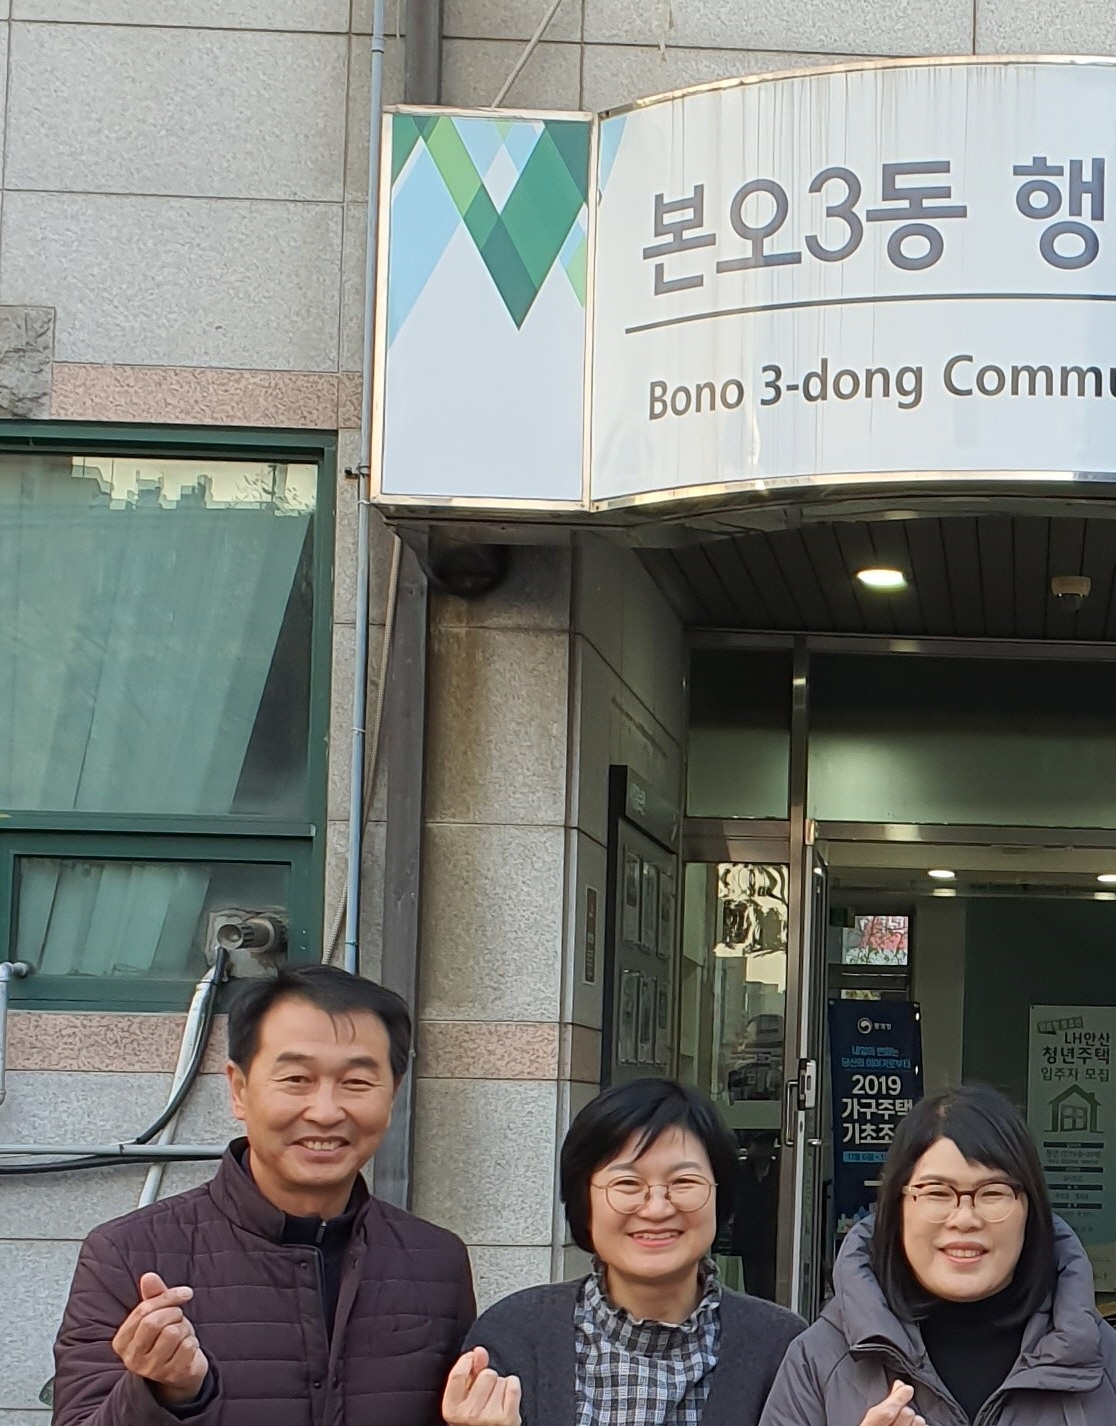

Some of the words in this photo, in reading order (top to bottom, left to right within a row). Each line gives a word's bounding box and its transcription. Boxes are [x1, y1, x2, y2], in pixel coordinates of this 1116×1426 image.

[643, 160, 967, 296] 본오3동
[648, 375, 745, 420] Bono
[760, 358, 923, 409] 3-dong
[1064, 1032, 1110, 1047] LH안산
[1042, 1046, 1110, 1065] 청년주택
[851, 1074, 902, 1096] 2019
[1041, 1067, 1078, 1081] 입주자
[1084, 1068, 1109, 1082] 모집
[841, 1098, 913, 1120] 가구주택
